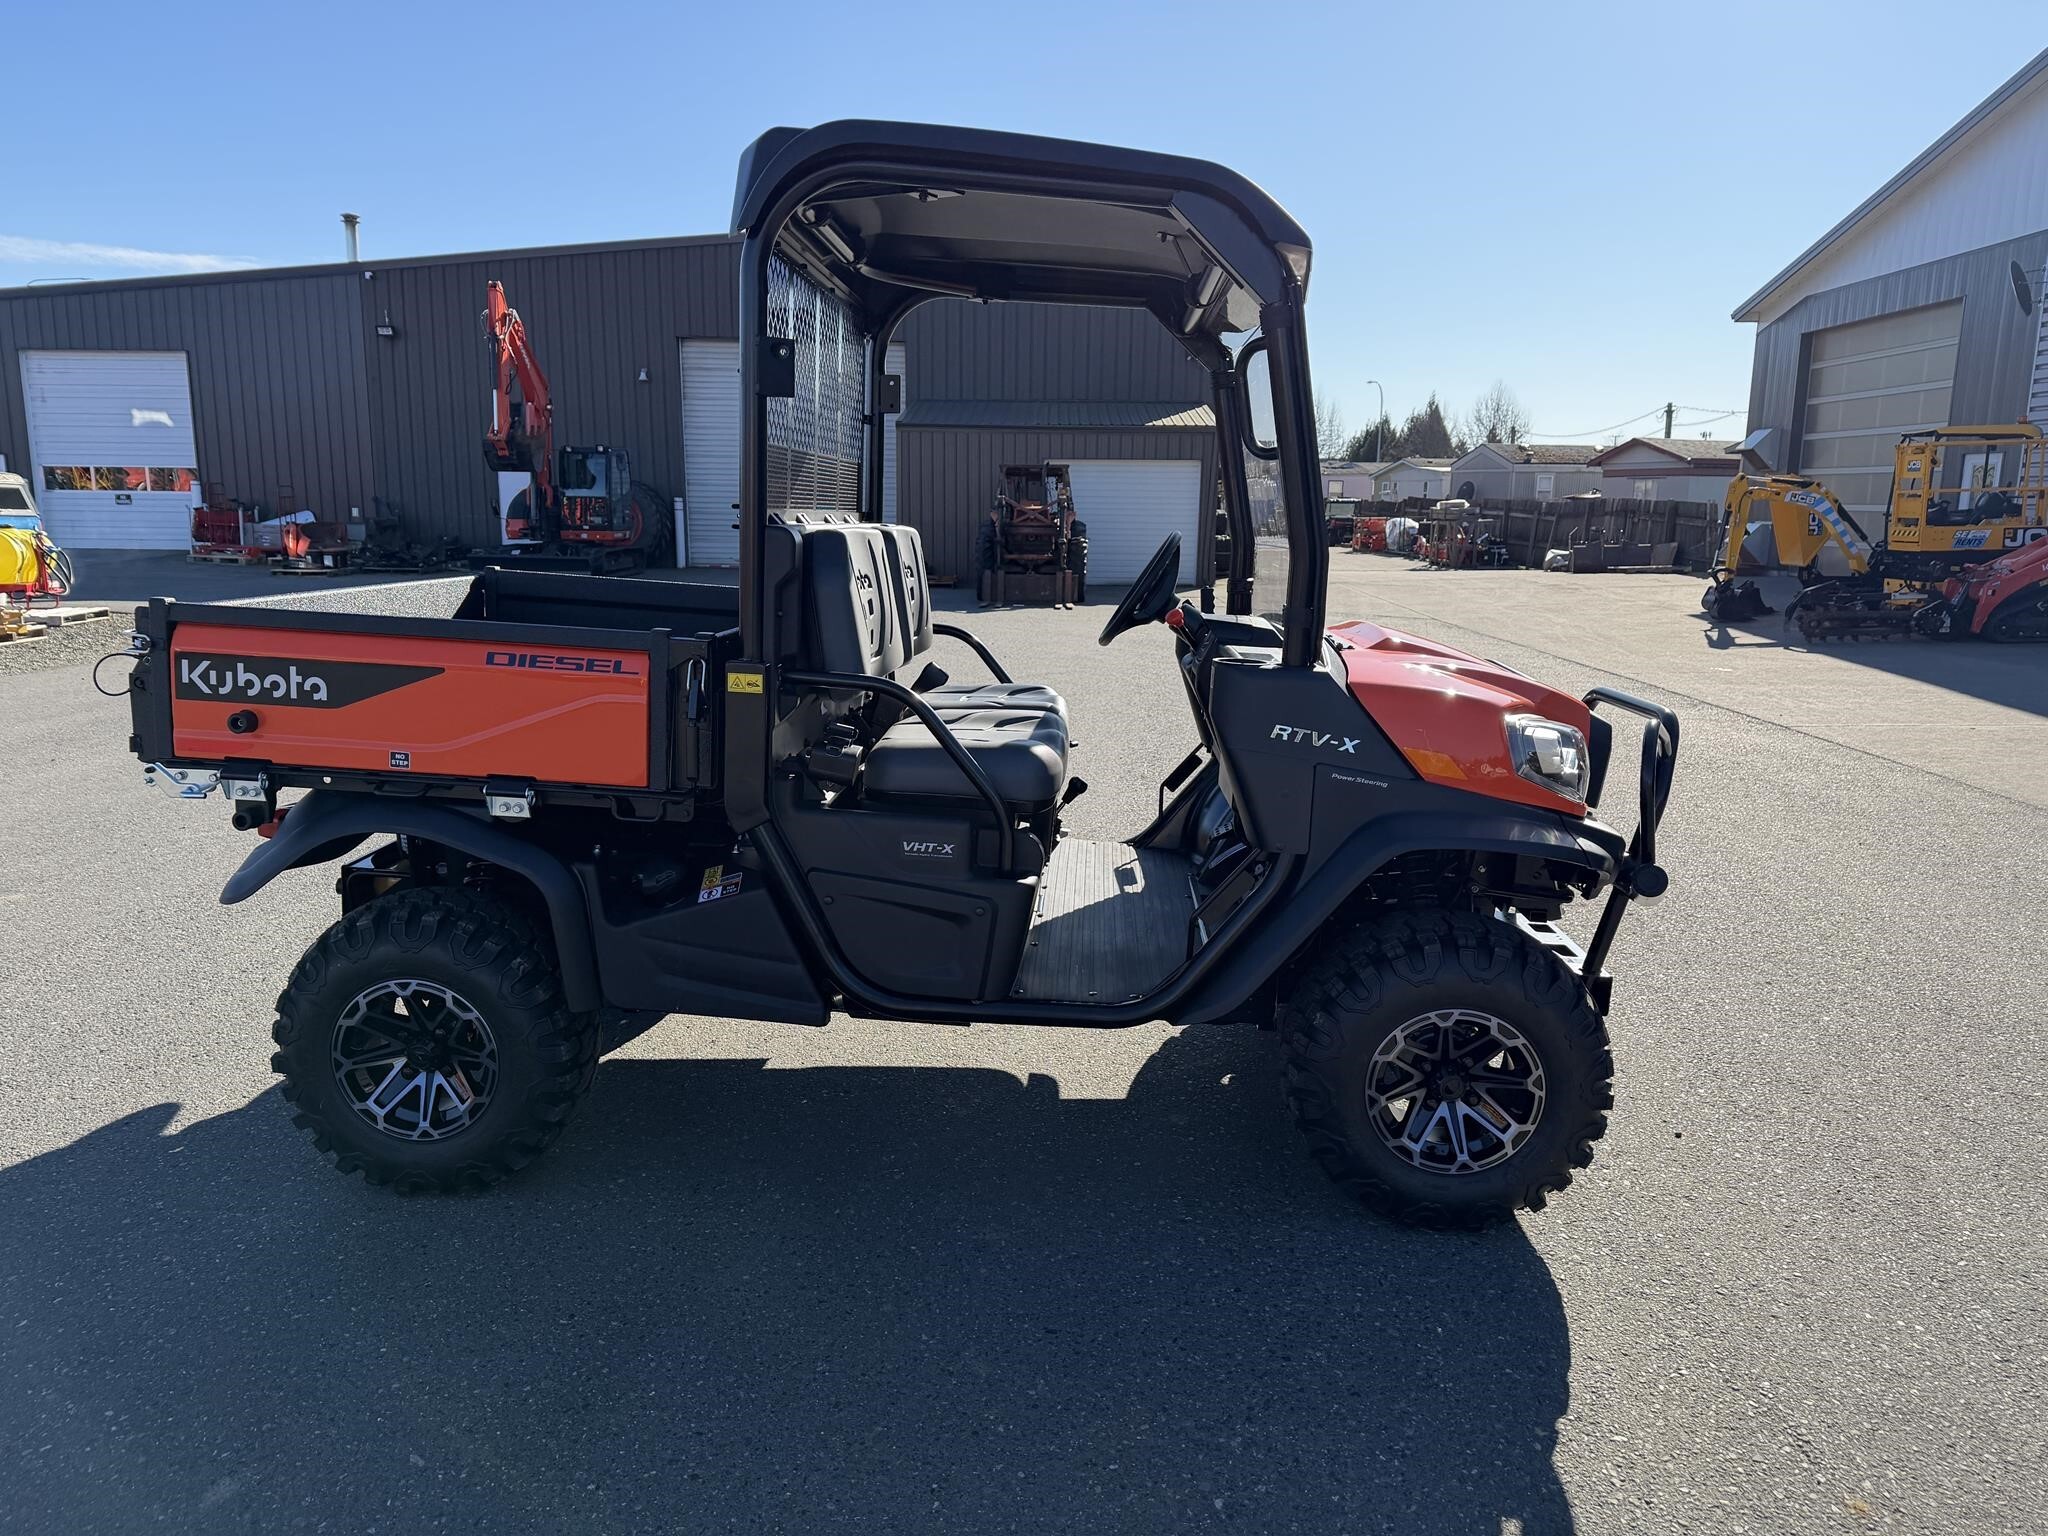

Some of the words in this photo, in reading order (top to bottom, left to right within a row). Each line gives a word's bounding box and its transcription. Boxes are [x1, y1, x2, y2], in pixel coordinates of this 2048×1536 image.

[1791, 493, 1815, 504] JCB
[1808, 513, 1819, 535] JC
[485, 651, 640, 675] DIESEL
[181, 659, 328, 701] Kubota
[1270, 724, 1360, 754] RTV-X
[1331, 773, 1355, 781] Power
[1355, 777, 1389, 788] Steering
[903, 841, 955, 854] VHT-X
